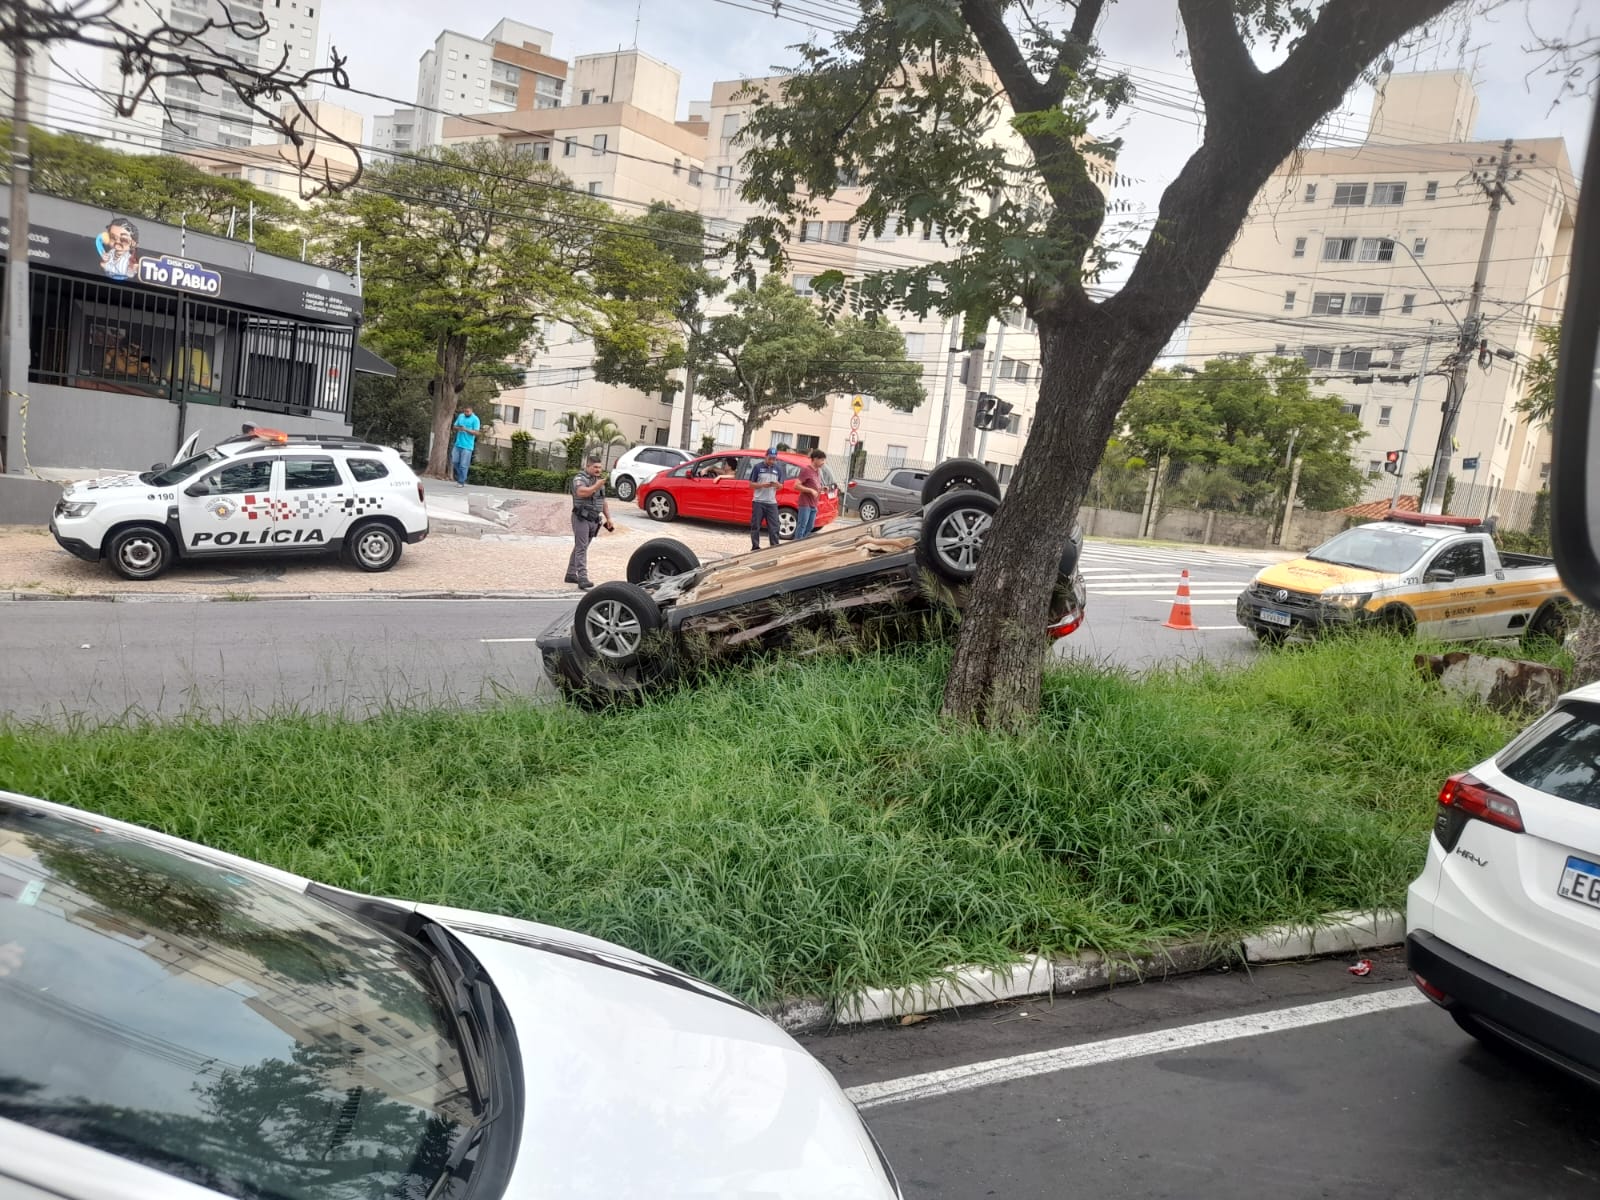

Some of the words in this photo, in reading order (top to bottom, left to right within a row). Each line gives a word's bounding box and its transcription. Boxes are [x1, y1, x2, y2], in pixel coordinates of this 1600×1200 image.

[183, 262, 195, 270] DO
[171, 267, 218, 292] PABLO
[158, 492, 175, 500] 190
[190, 526, 325, 547] POLÍCIA
[1406, 576, 1419, 585] 273
